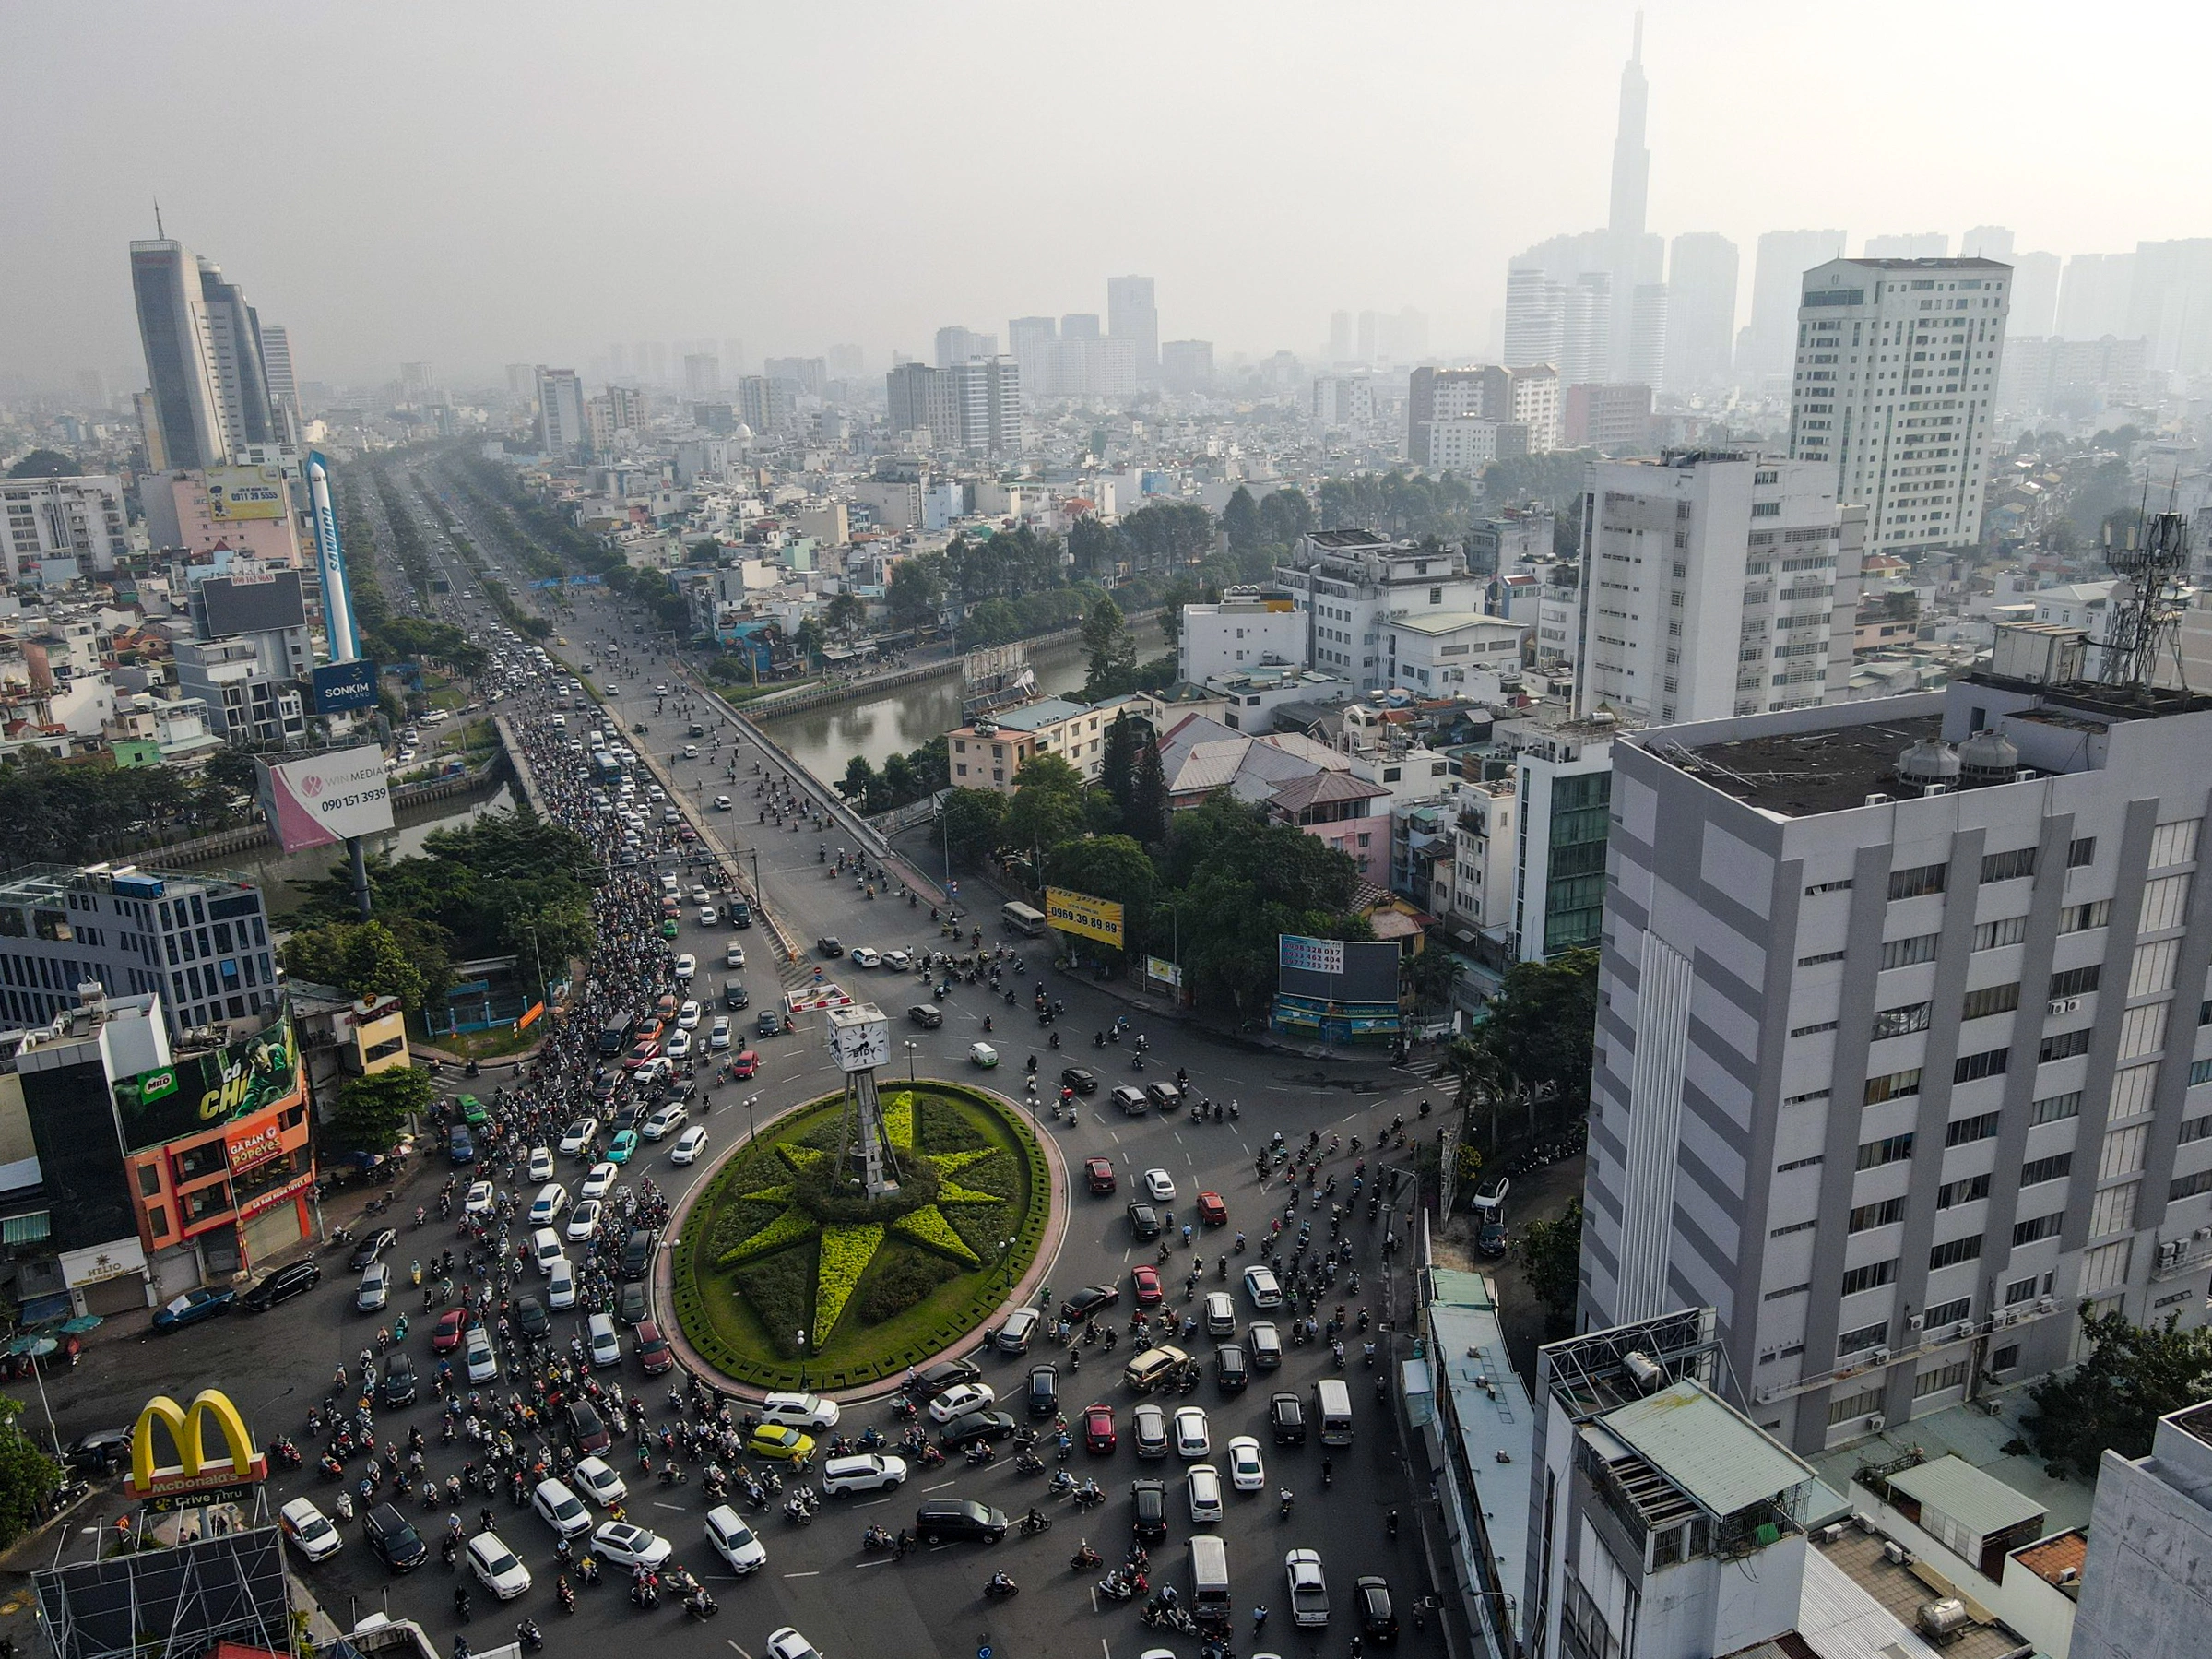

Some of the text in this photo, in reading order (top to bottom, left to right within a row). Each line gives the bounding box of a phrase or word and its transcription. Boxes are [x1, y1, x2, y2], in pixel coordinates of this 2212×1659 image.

[231, 492, 248, 501] 0911
[261, 491, 278, 499] 5555
[322, 506, 340, 573] SAWACO
[325, 682, 369, 698] SONKIM
[350, 692, 370, 700] LAND
[325, 767, 384, 787] WIN MEDIA
[322, 788, 386, 812] 090 151 3939
[223, 1058, 242, 1083] CÓ
[148, 1077, 171, 1090] MILO
[231, 1134, 265, 1154] GÀ RÁN
[88, 1262, 121, 1276] HELIO
[152, 1473, 239, 1494] McDonald's
[175, 1488, 242, 1507] Drive Thru
